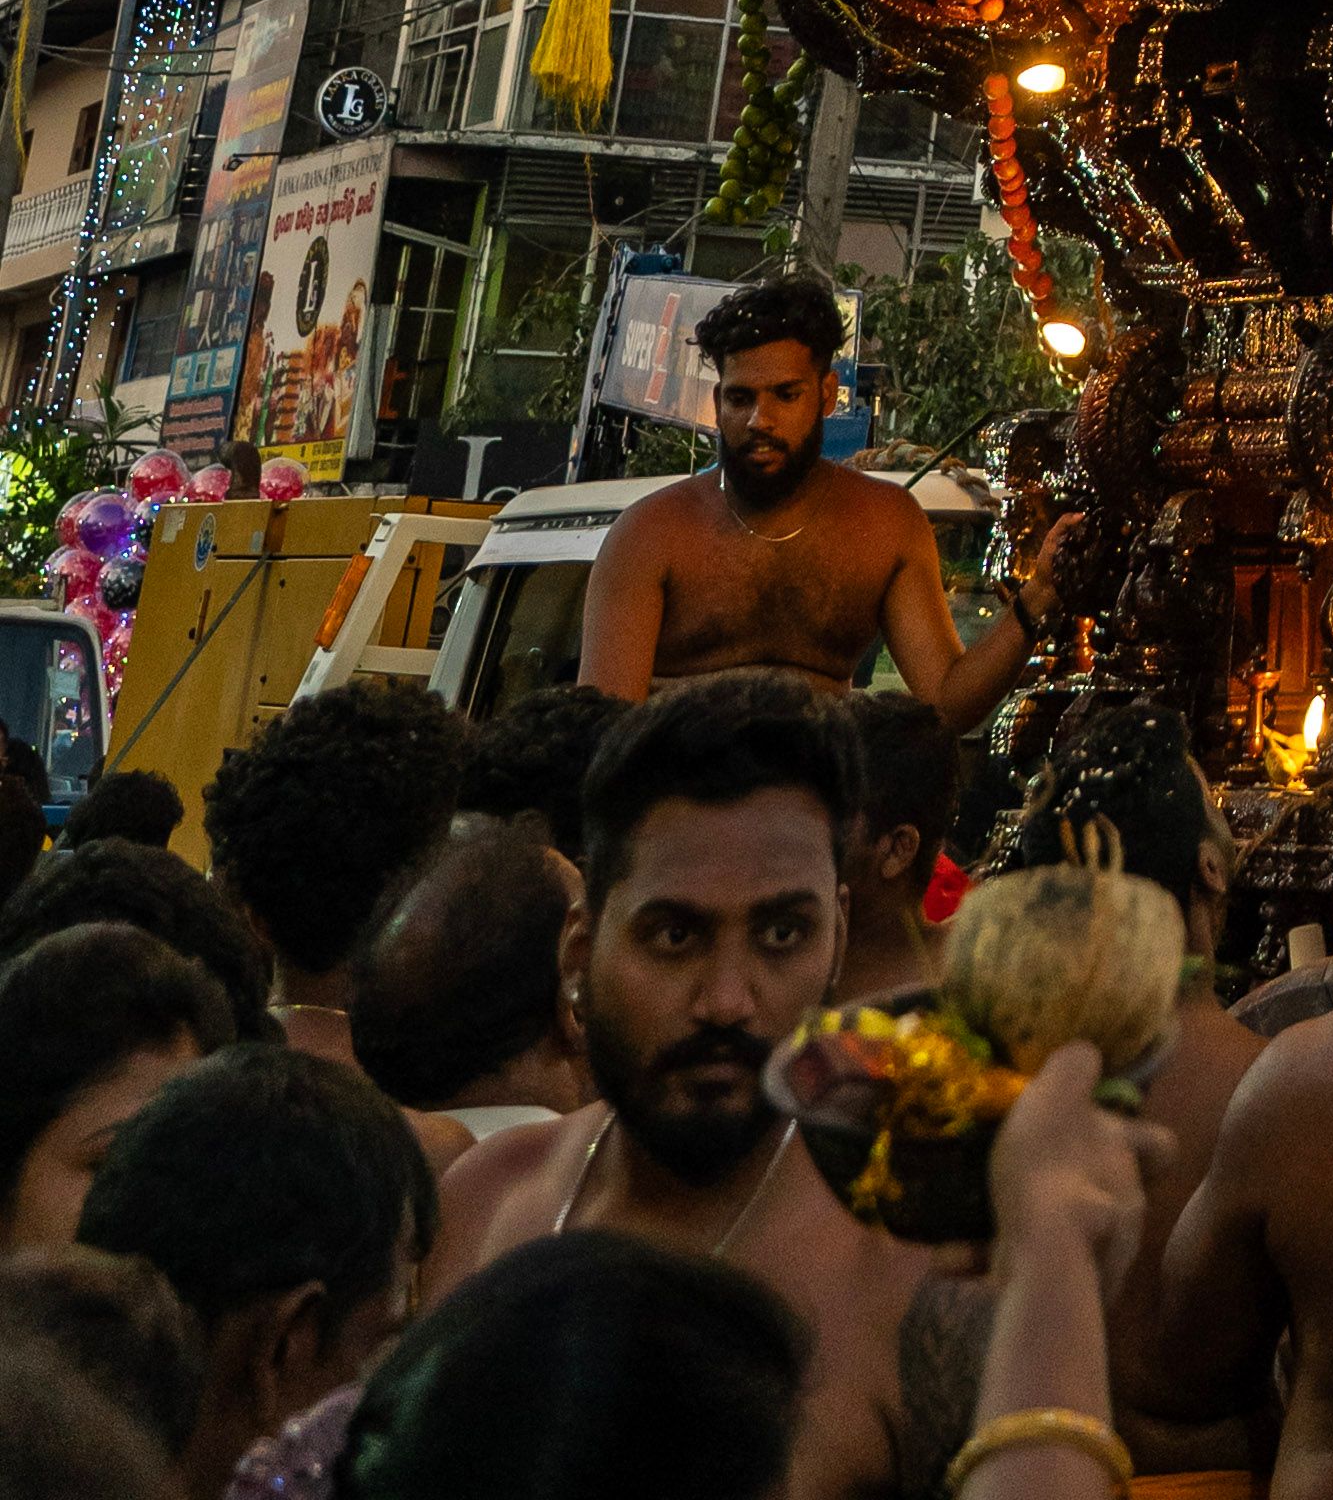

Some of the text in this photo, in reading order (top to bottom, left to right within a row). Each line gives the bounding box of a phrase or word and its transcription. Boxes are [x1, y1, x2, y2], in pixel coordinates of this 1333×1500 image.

[323, 69, 359, 102] LANKA
[278, 176, 301, 198] LANKA
[621, 319, 657, 372] SUPER
